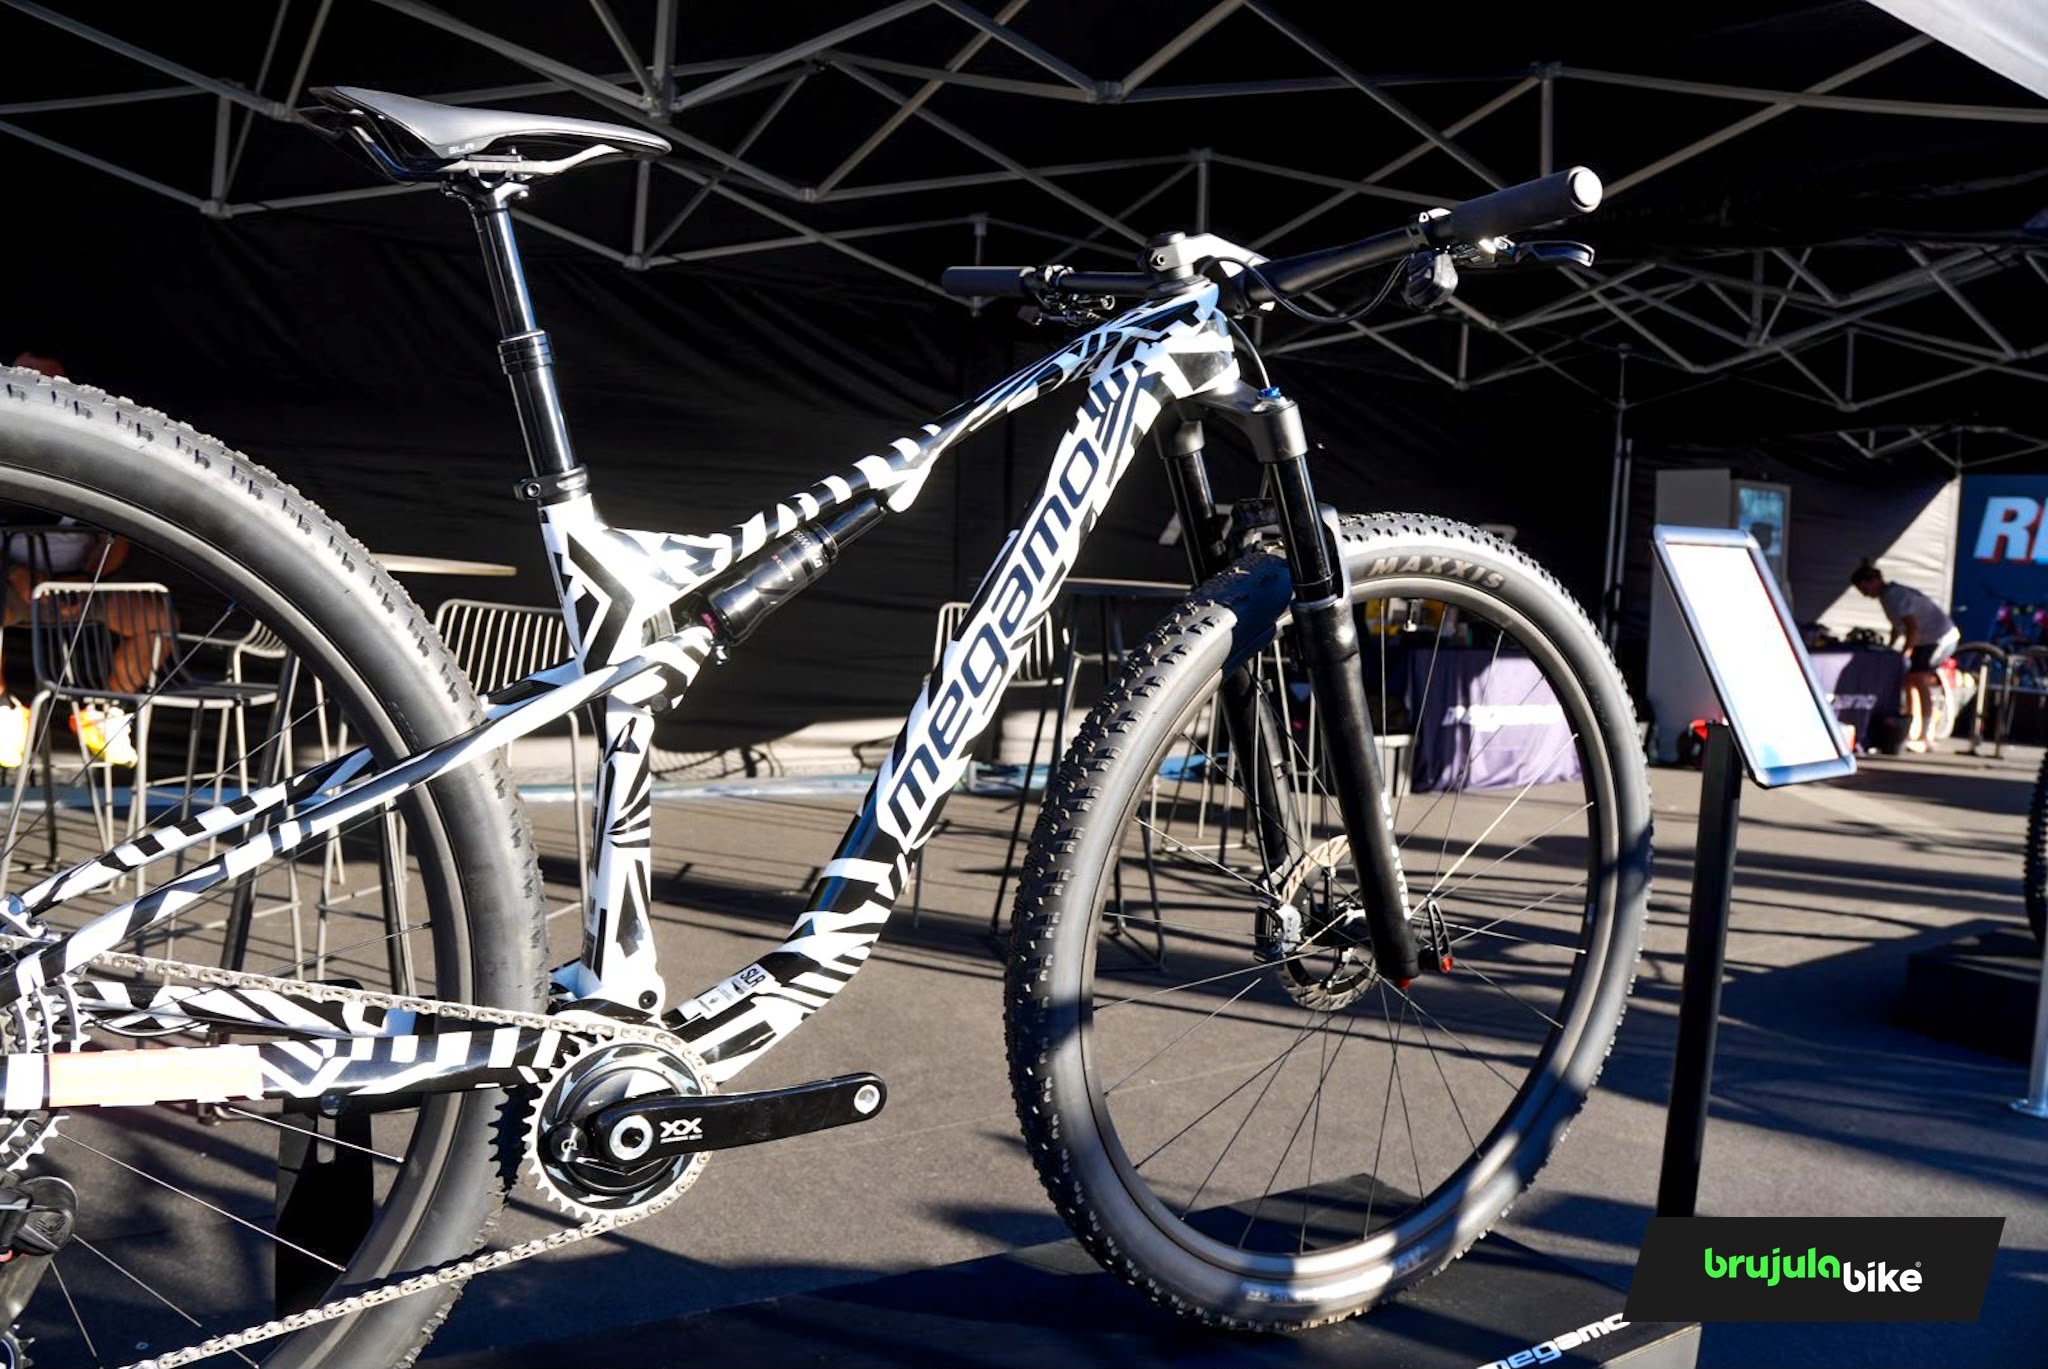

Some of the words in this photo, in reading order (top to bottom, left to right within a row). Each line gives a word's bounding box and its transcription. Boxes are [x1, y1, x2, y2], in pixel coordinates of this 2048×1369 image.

[1368, 555, 1504, 588] MAXXIS
[888, 437, 1099, 838] megamo
[660, 1117, 703, 1138] XX
